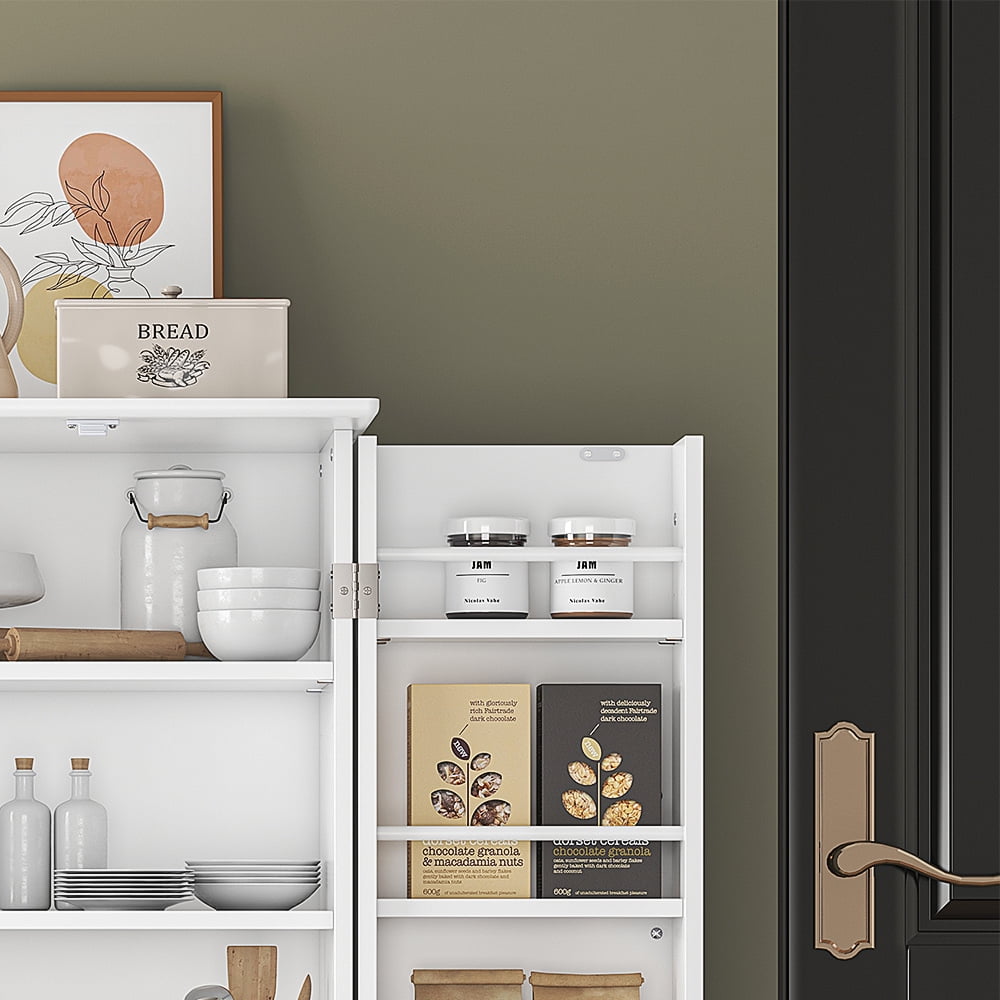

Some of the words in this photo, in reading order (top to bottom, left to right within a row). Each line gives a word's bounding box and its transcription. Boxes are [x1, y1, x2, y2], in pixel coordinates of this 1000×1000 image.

[137, 323, 209, 339] BREAD
[471, 560, 492, 570] JAM
[577, 560, 597, 570] JAM
[453, 740, 468, 758] new
[584, 741, 599, 758] new
[422, 846, 475, 856] chocolate
[477, 846, 521, 857] granola
[553, 846, 606, 856] chocolate
[608, 846, 652, 857] granola
[422, 857, 433, 866] &
[434, 857, 497, 866] macadamia
[500, 857, 524, 866] nuts
[553, 888, 572, 896] 600g
